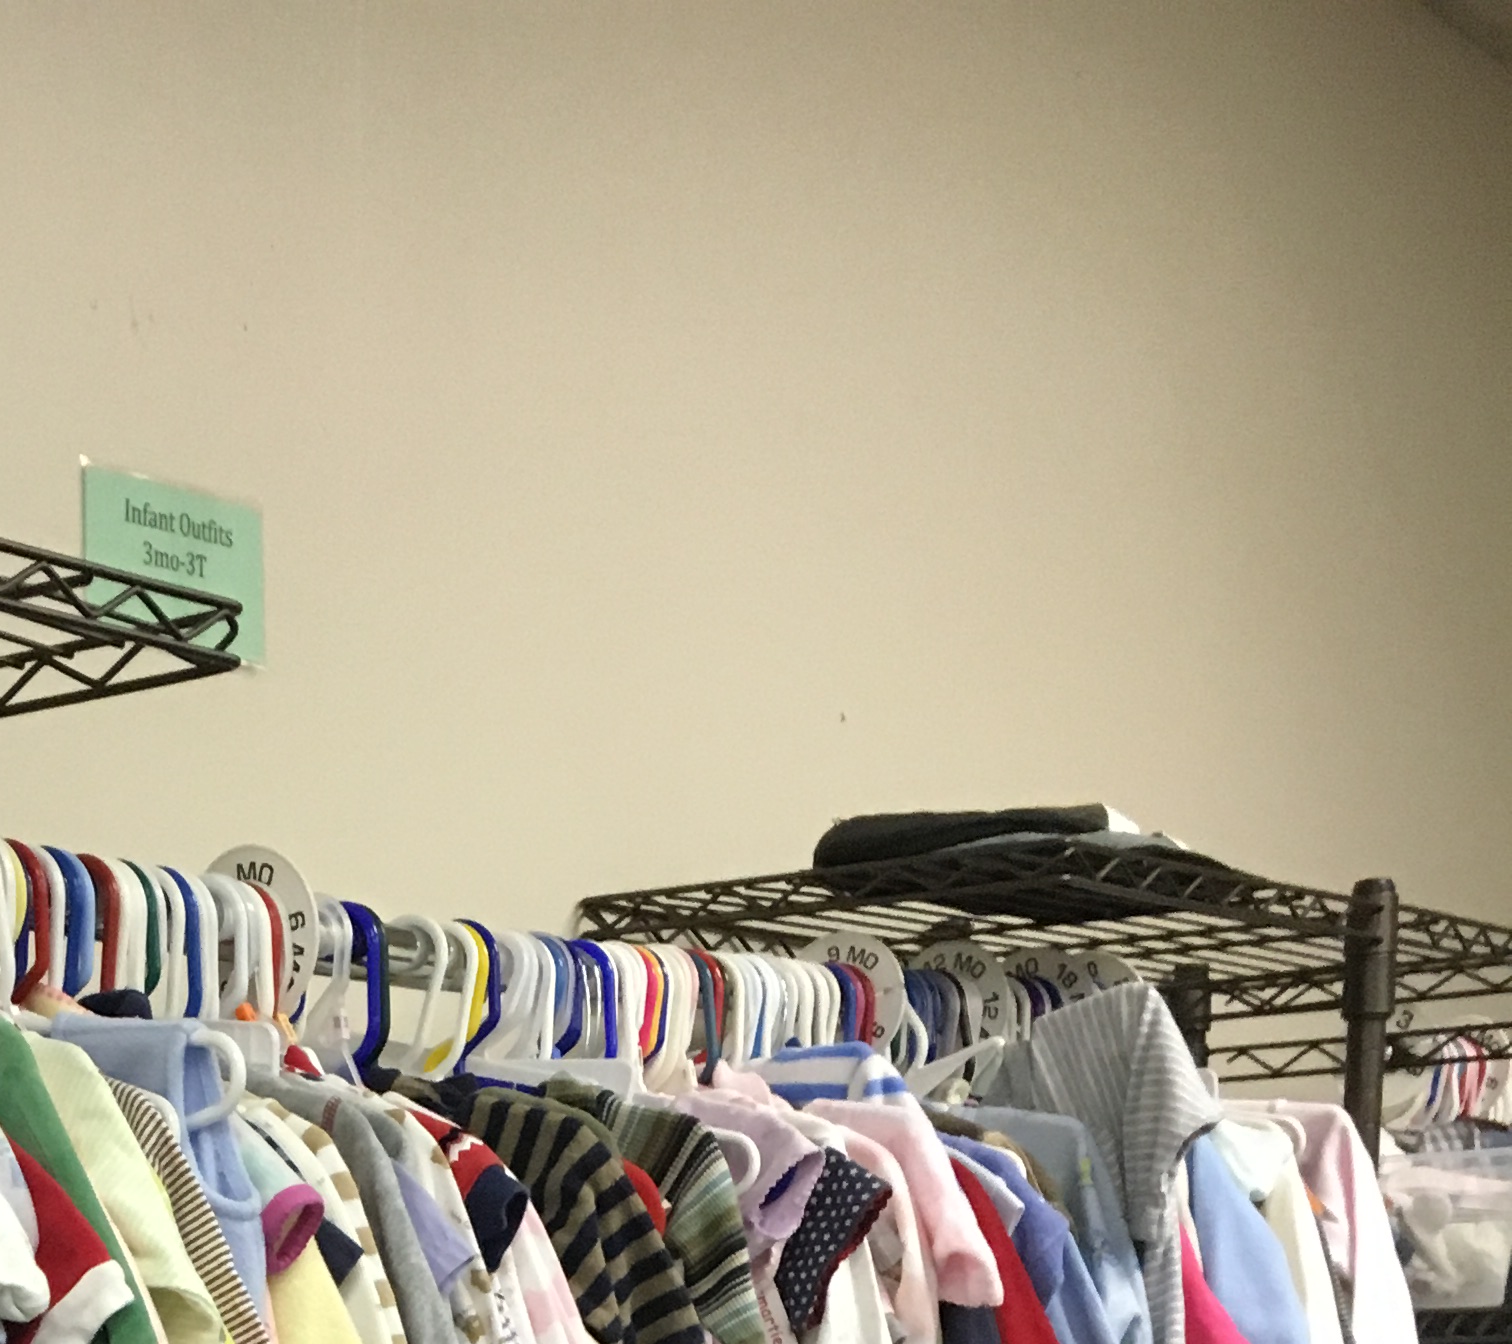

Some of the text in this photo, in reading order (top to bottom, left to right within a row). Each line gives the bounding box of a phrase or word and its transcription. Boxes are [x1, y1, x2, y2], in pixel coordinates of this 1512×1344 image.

[124, 498, 234, 548] Infant Outfits
[142, 541, 207, 578] 3mo-3T
[237, 861, 275, 887] MO
[846, 945, 879, 970] MO
[953, 951, 987, 979] MO
